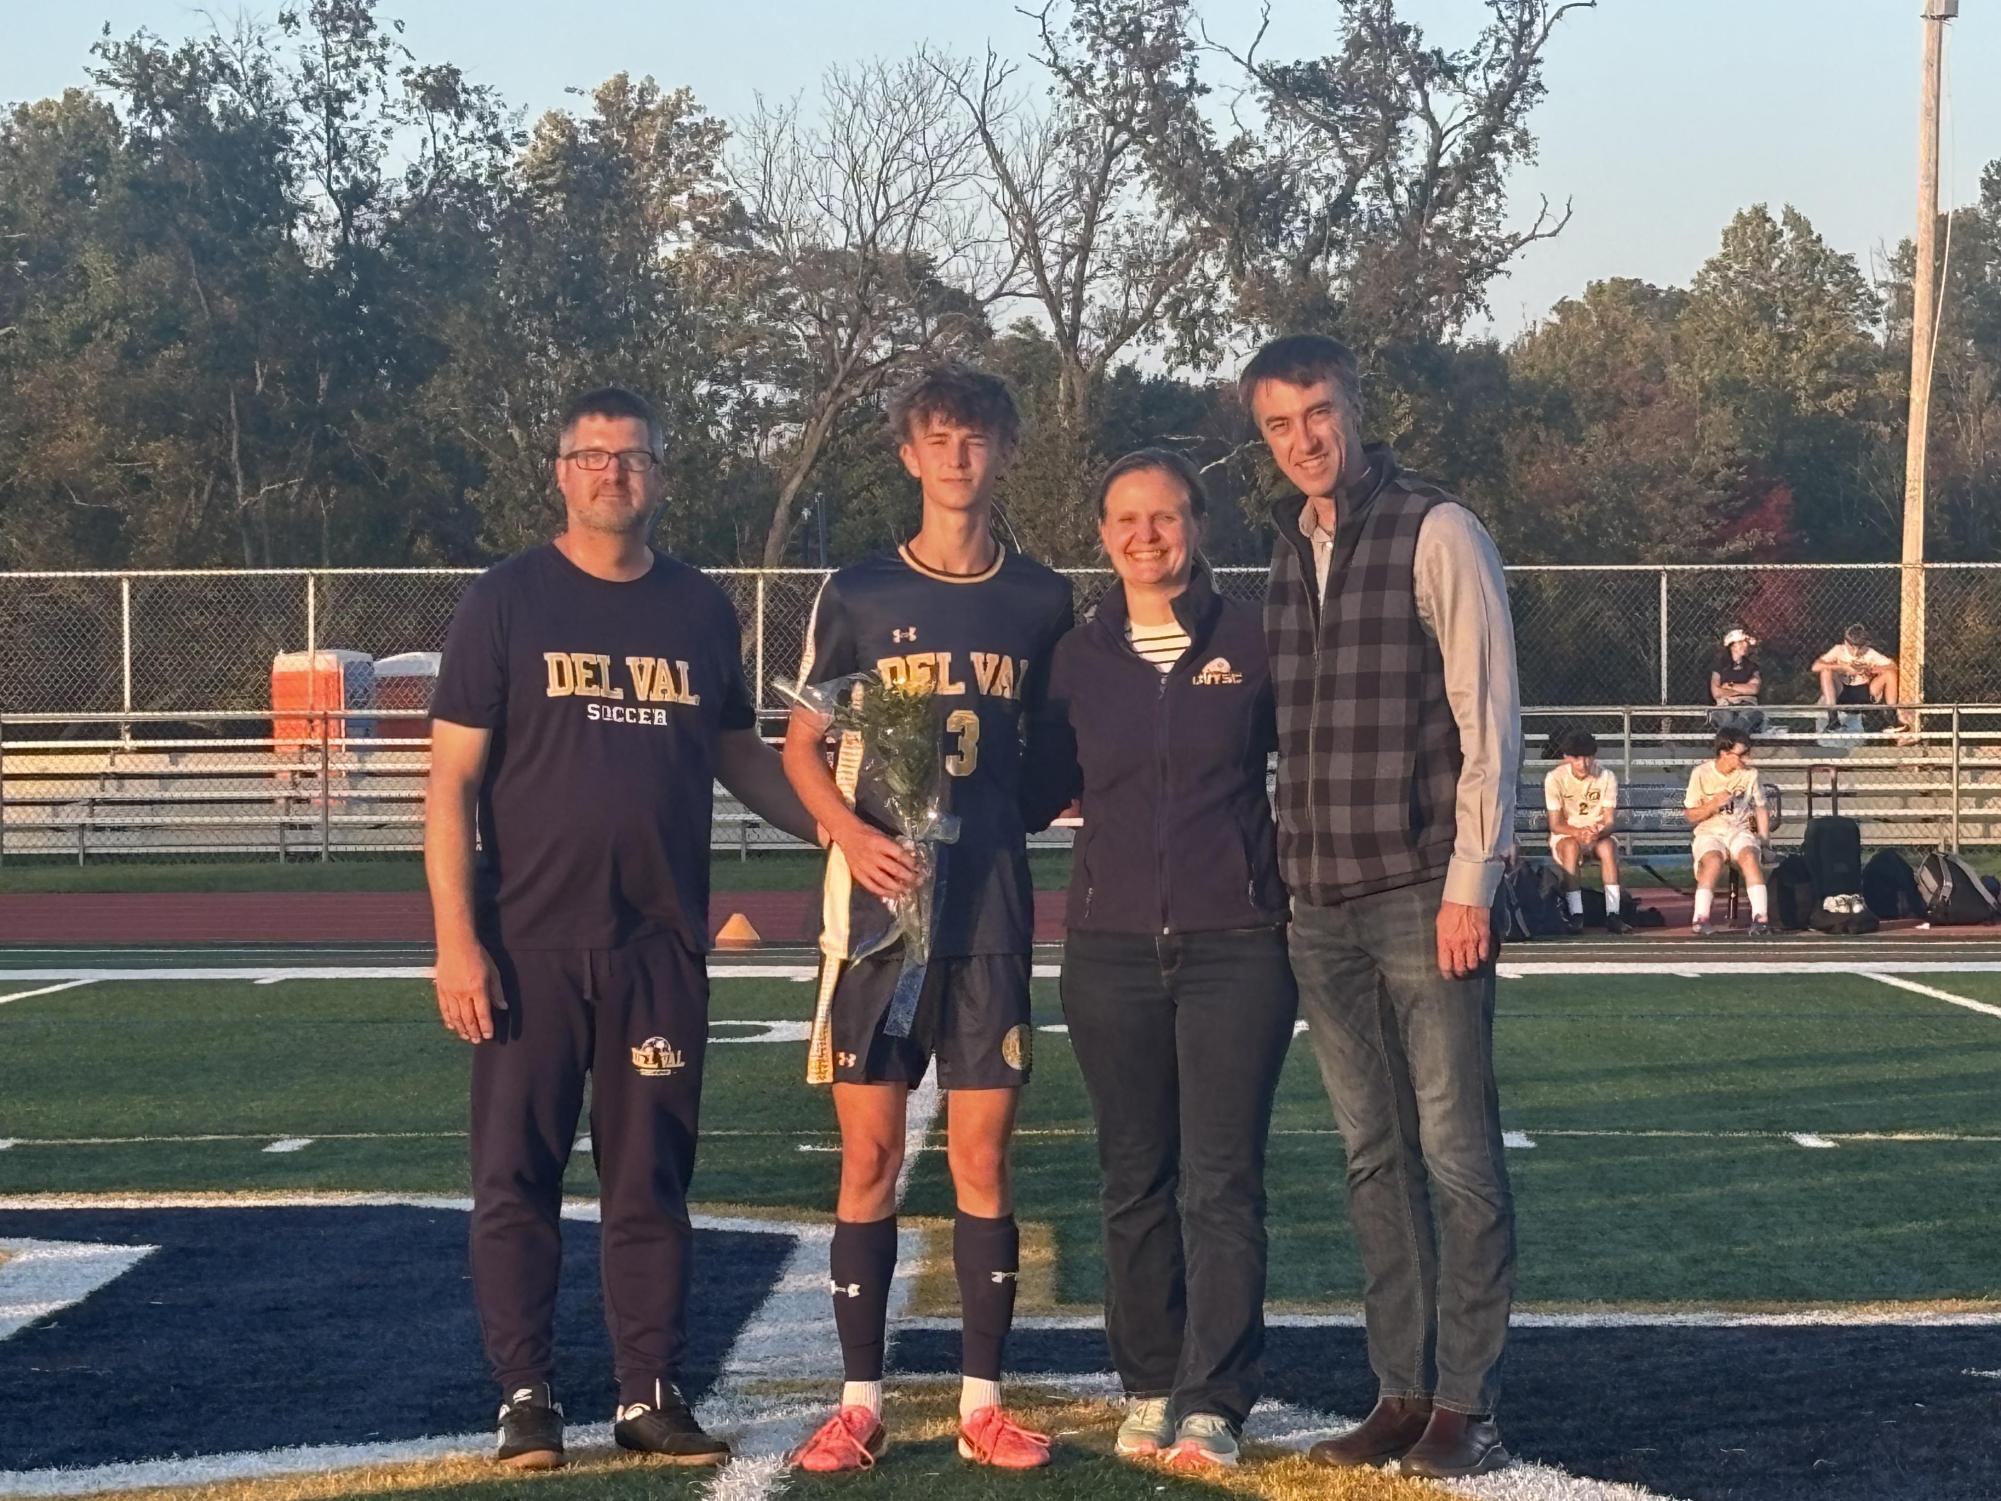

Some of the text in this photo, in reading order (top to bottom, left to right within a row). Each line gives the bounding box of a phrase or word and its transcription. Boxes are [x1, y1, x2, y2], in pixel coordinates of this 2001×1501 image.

[543, 652, 700, 706] DEL VAL
[877, 652, 966, 696] DEL
[587, 703, 668, 726] SOCCER
[945, 709, 980, 777] 3
[1579, 802, 1589, 815] 2
[659, 1050, 686, 1069] VAL
